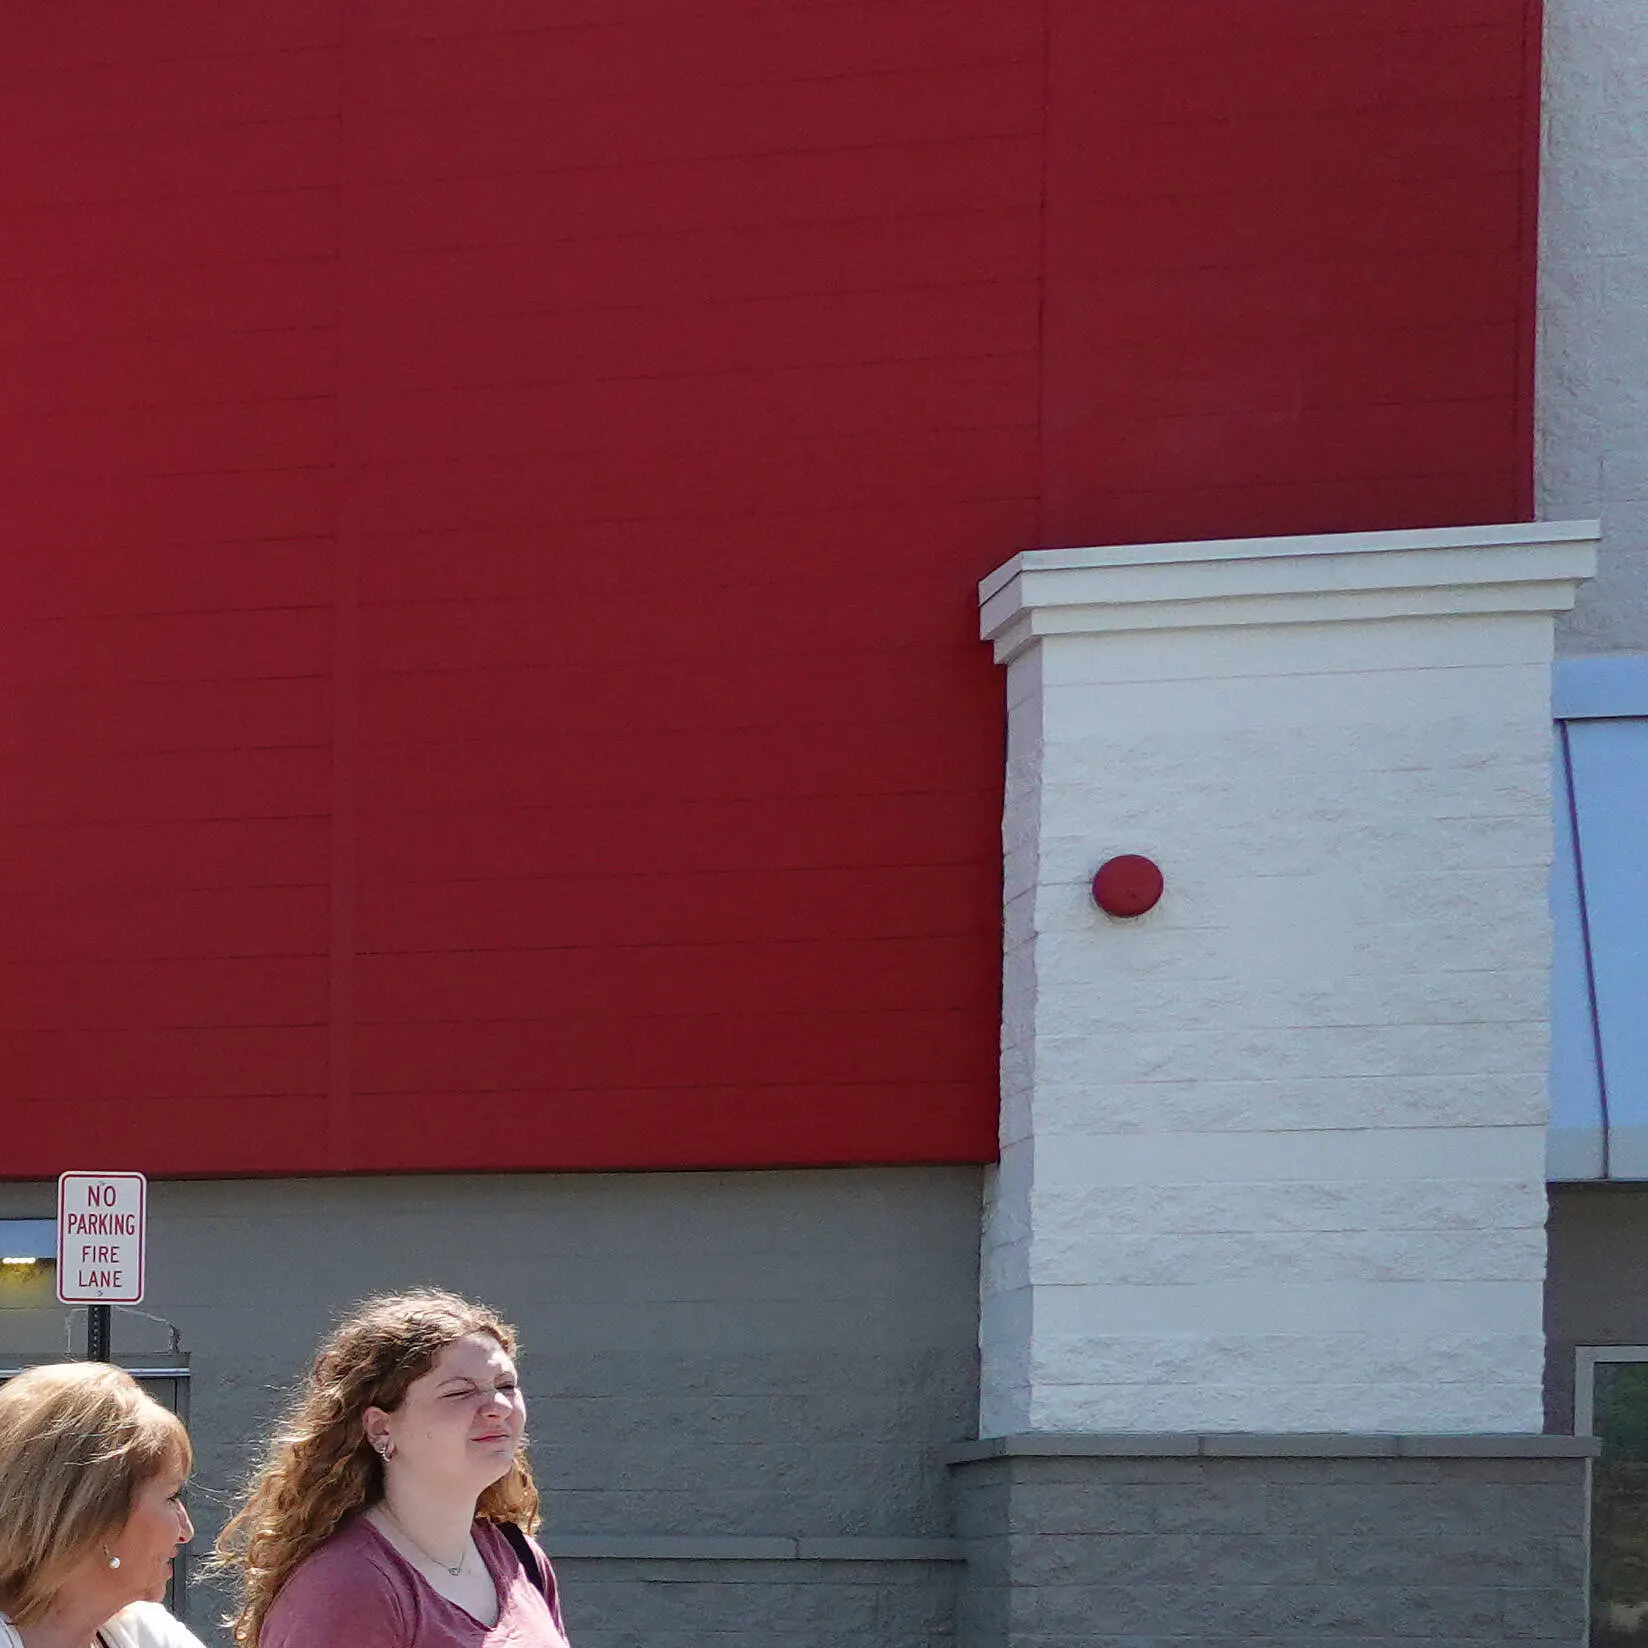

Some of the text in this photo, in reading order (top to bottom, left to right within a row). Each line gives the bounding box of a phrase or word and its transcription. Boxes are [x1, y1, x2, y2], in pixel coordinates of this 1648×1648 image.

[87, 1185, 116, 1207] NO
[67, 1213, 136, 1236] PARKING
[82, 1245, 120, 1263] FIRE
[78, 1270, 123, 1288] LANE
